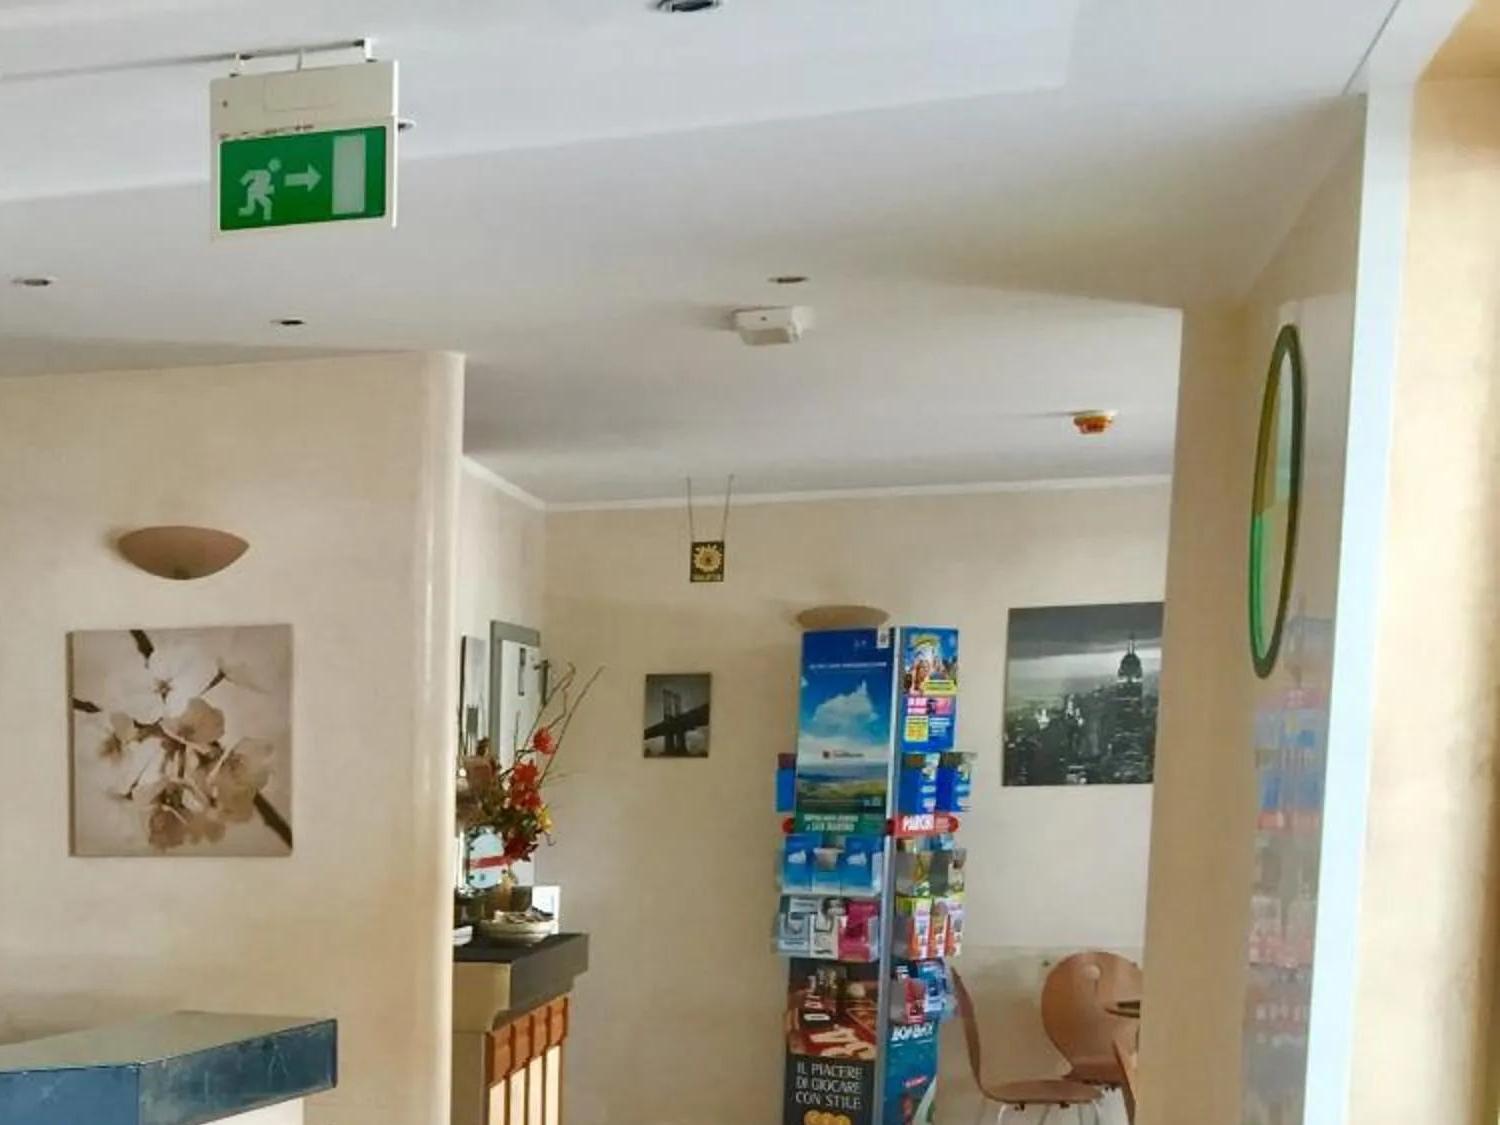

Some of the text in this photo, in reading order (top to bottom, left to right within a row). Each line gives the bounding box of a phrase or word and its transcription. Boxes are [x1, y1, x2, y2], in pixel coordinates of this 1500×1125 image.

[797, 1061, 864, 1079] IL PIACERE
[796, 1075, 862, 1094] DI GIOCARE
[795, 1091, 862, 1110] CON STILE
